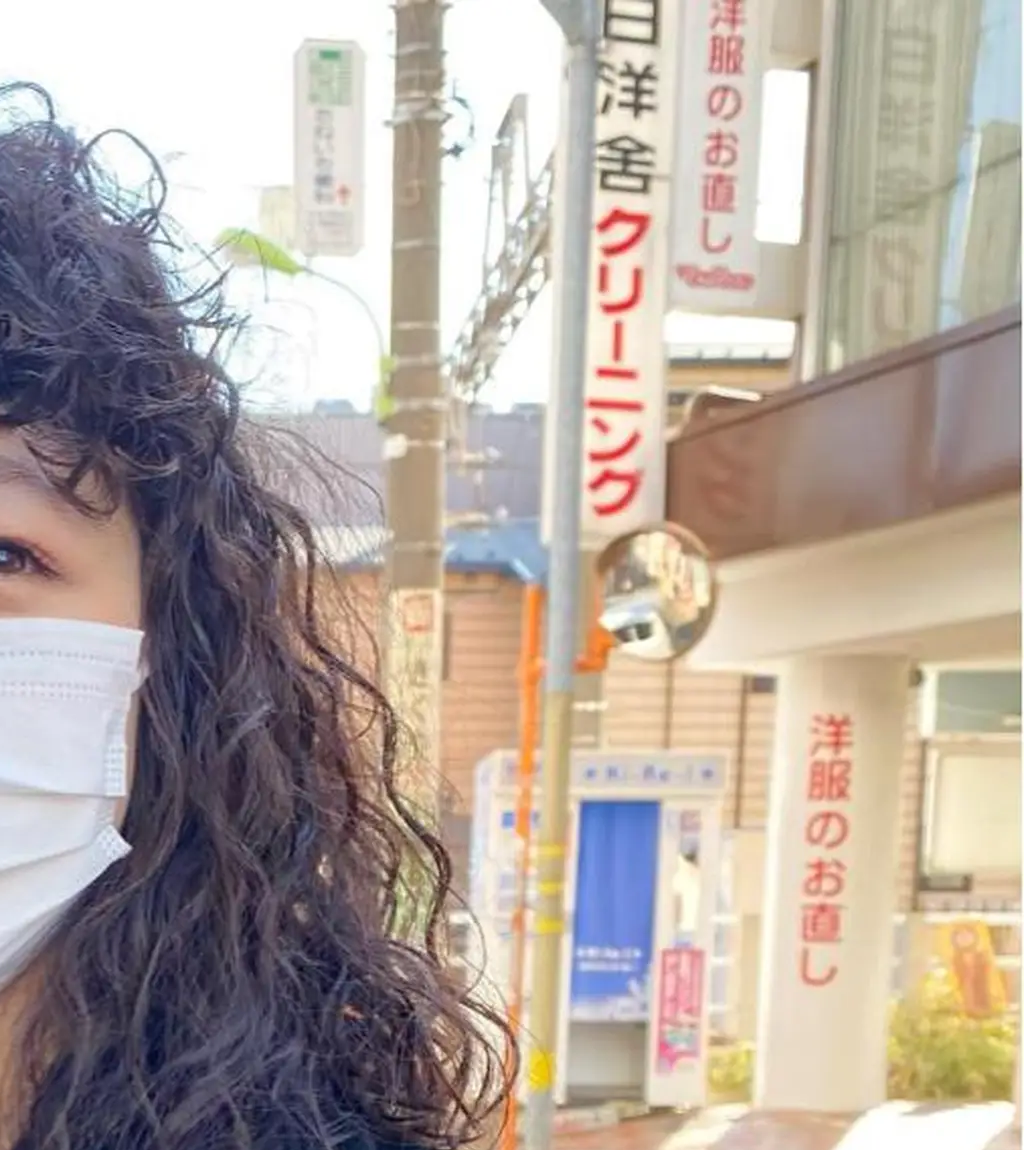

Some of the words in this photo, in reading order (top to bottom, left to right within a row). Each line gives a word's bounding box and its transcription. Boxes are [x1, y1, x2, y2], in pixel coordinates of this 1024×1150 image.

[701, 0, 745, 253] 洋服のお直し
[800, 714, 853, 986] 洋服のお直し
